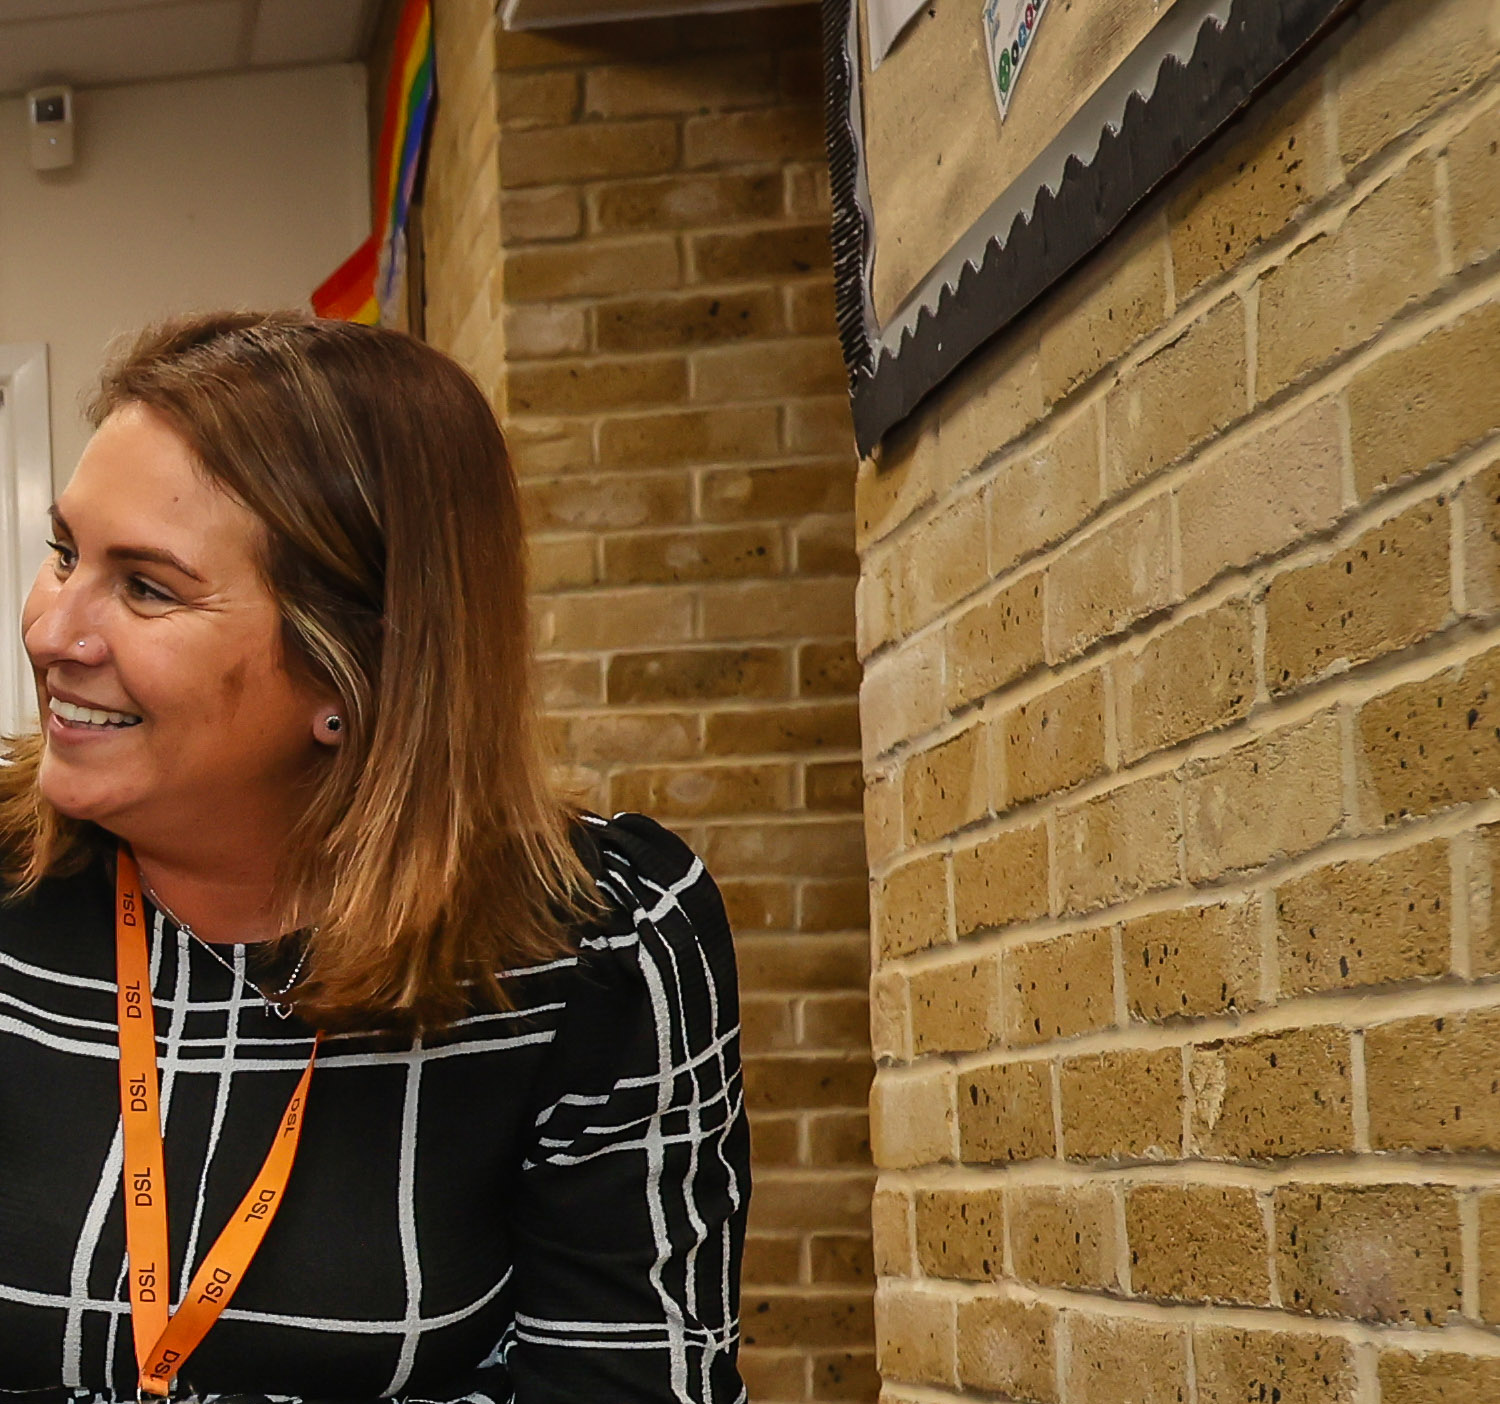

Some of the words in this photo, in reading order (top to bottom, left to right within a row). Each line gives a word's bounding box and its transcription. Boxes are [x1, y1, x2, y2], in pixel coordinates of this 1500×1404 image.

[122, 889, 136, 927] DSL
[126, 979, 141, 1019] DSL
[130, 1072, 148, 1112] DSL
[283, 1097, 300, 1138] DSL
[135, 1166, 151, 1207] DSL
[244, 1189, 276, 1223] DSL
[139, 1261, 156, 1302] DSL
[197, 1267, 232, 1305] DSL
